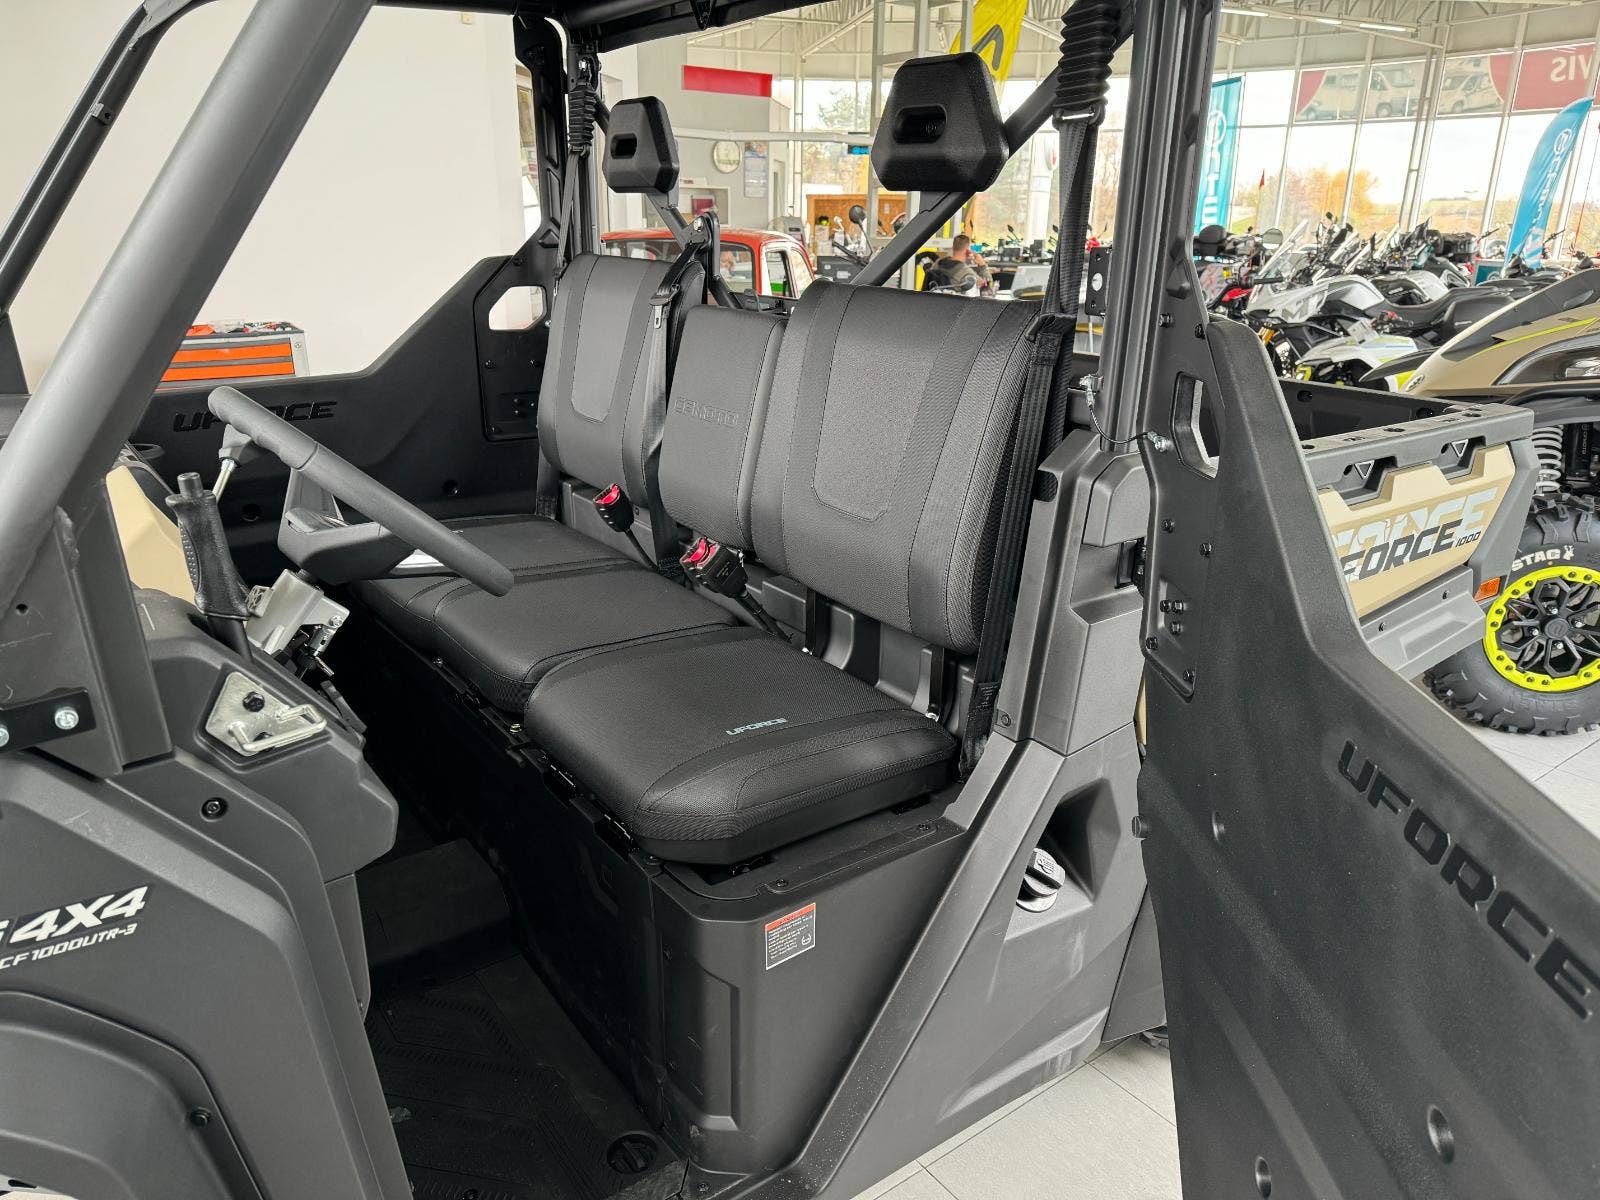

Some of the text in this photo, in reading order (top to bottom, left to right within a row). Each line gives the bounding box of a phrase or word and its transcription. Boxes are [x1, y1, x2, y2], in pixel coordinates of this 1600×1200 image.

[1455, 531, 1482, 548] 1000
[726, 717, 787, 735] UFORCE
[1338, 740, 1600, 1020] UFORCE
[9, 886, 148, 944] 4X4
[0, 923, 138, 969] CF1000UTR-3
